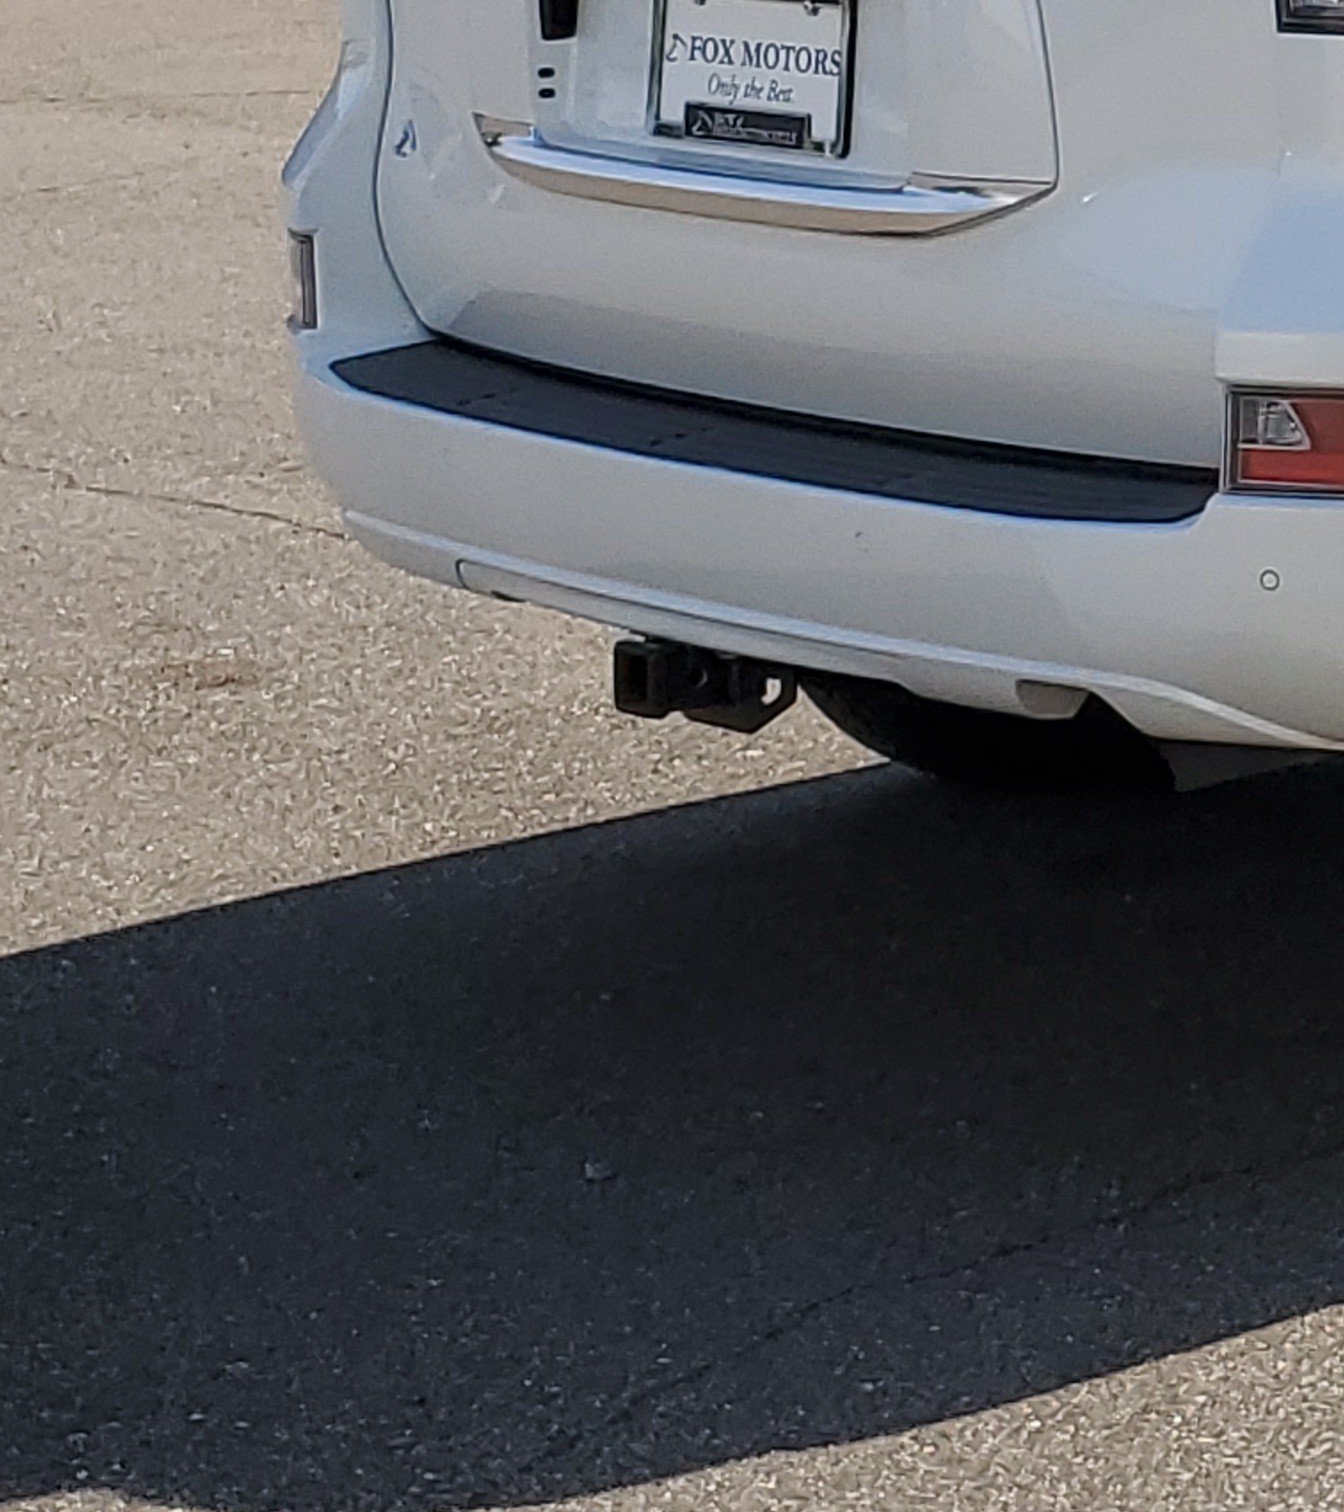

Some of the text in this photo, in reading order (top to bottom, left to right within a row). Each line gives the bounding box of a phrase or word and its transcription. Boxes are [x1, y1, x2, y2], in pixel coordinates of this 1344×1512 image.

[688, 35, 842, 76] FOX MOTORS
[707, 73, 741, 105] Only
[743, 76, 764, 99] the
